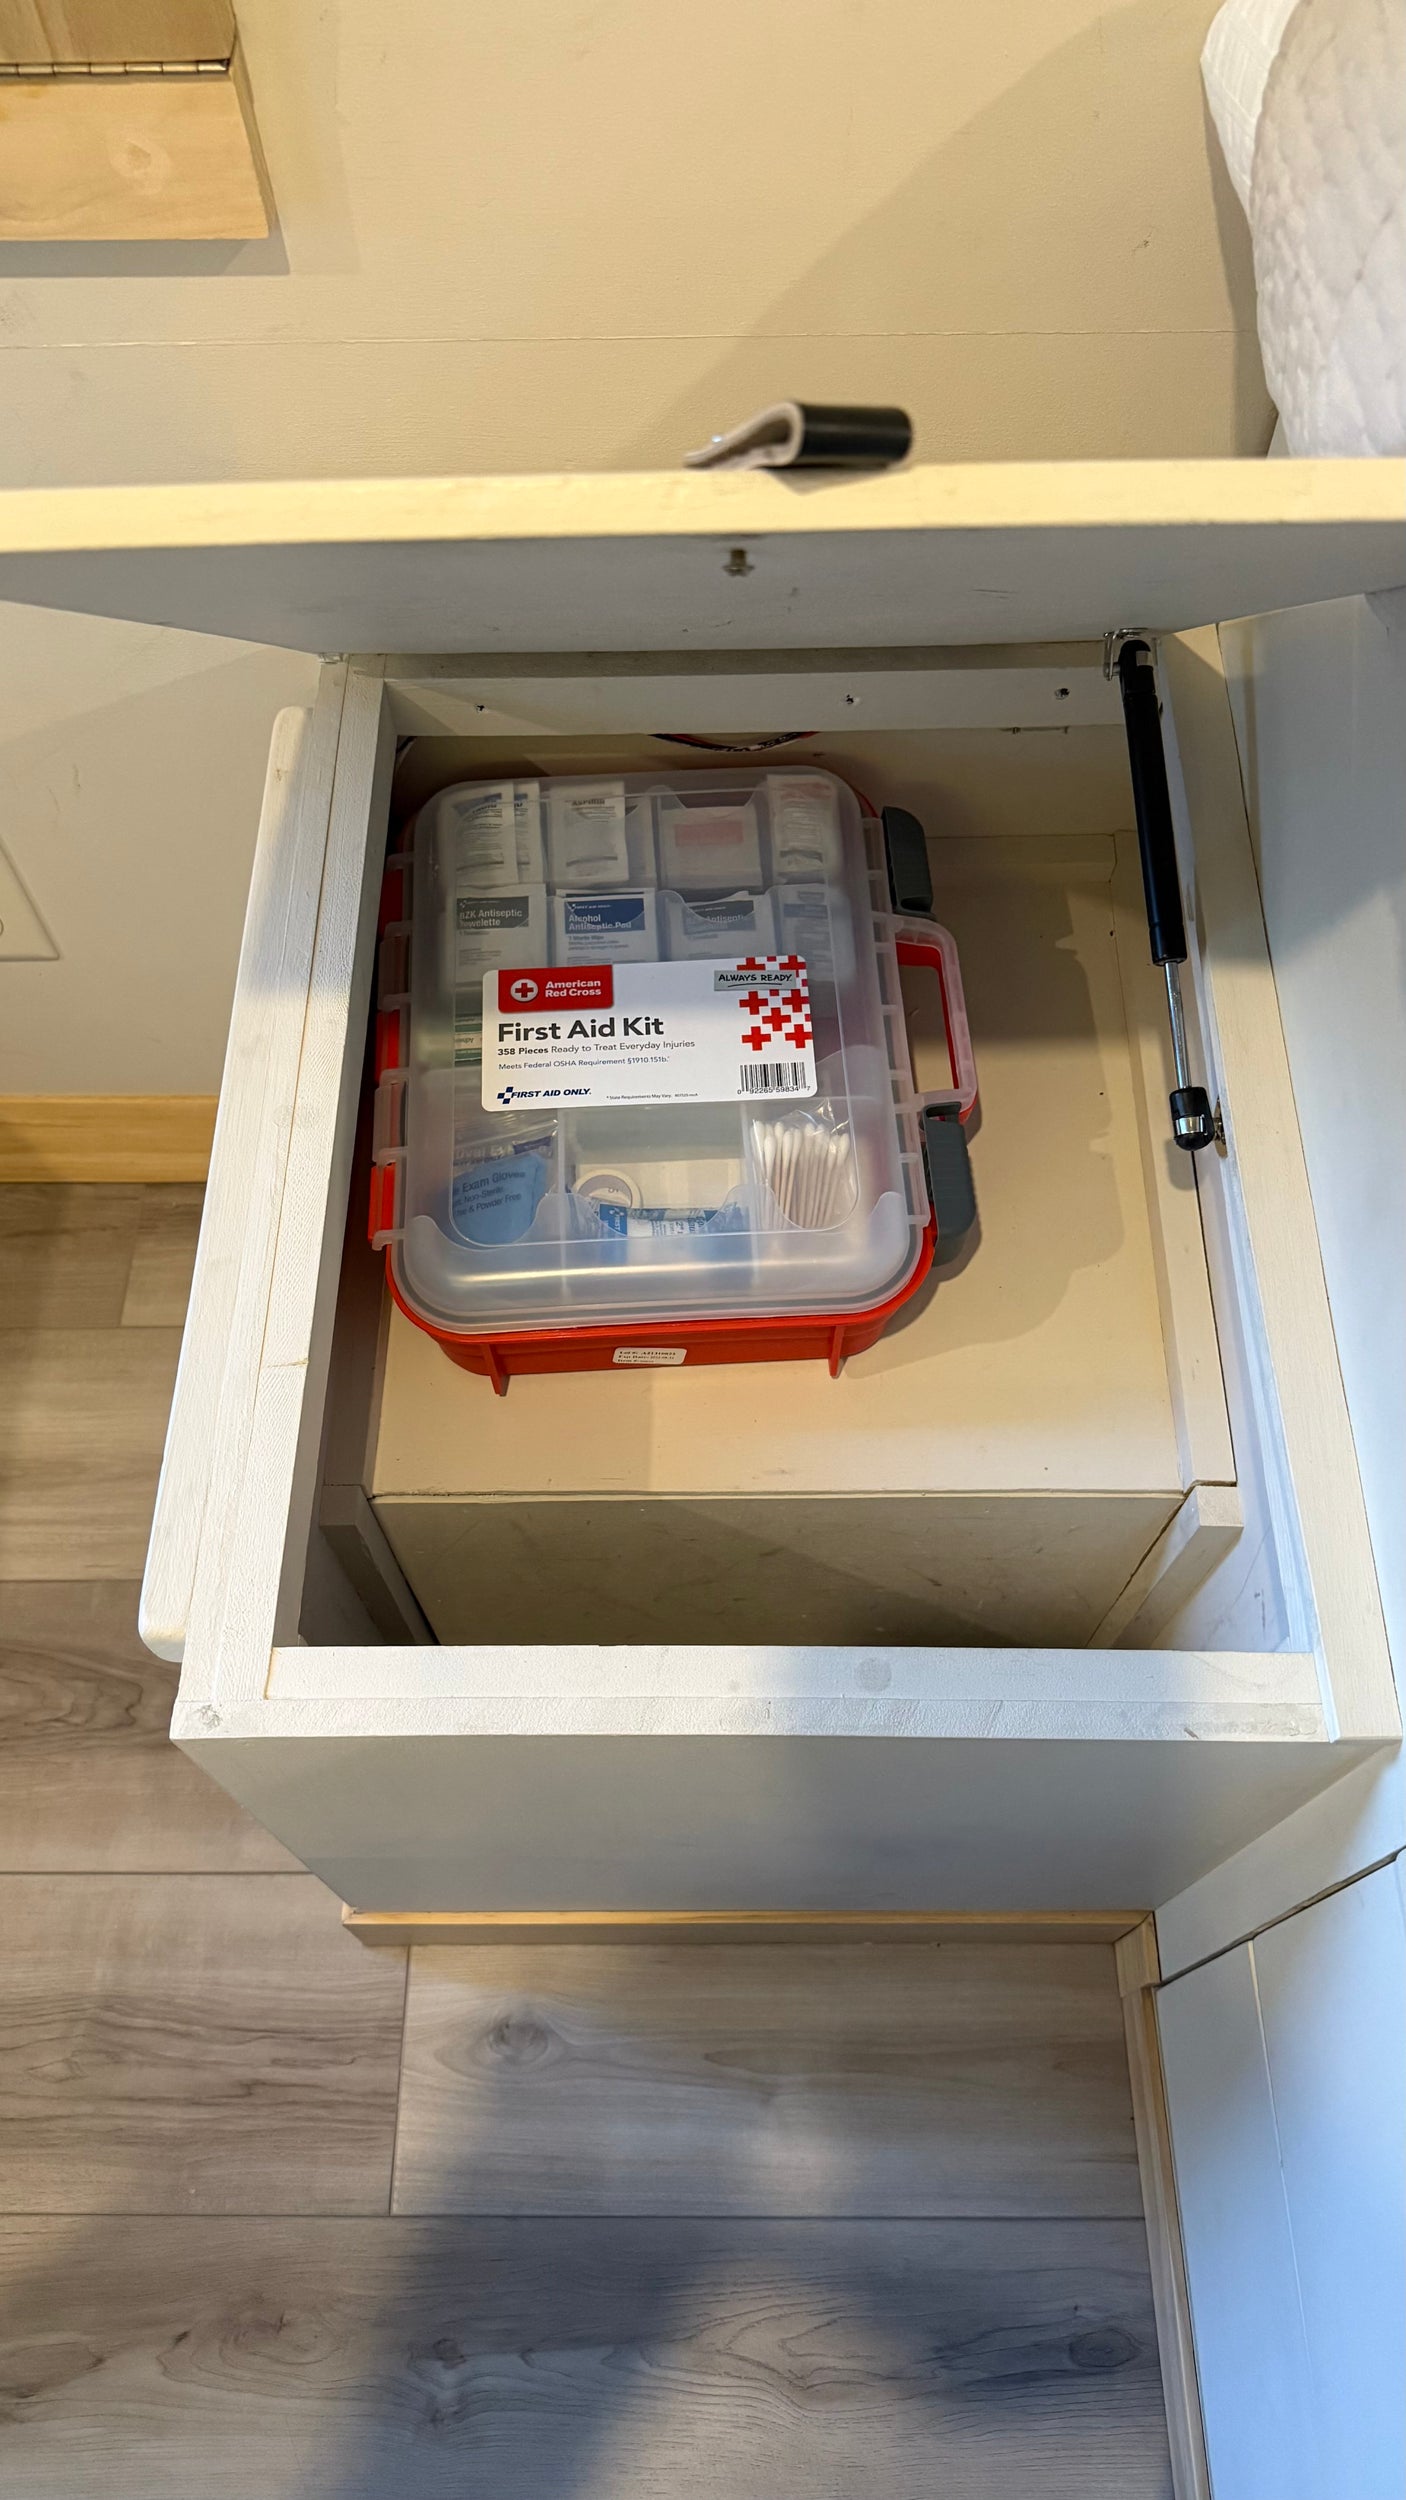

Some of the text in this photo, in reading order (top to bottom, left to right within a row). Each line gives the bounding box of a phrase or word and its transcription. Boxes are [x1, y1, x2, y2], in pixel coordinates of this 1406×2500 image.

[478, 908, 523, 918] Antiseptic
[569, 914, 601, 922] Alcohol
[718, 974, 757, 982] ALWAYS
[545, 979, 602, 989] American
[545, 987, 602, 998] Red Cross
[498, 1016, 664, 1042] First Aid Kit
[498, 1048, 516, 1056] 358
[518, 1047, 549, 1055] Pieces
[551, 1045, 580, 1054] Ready
[594, 1043, 617, 1051] Treat
[619, 1041, 661, 1051] Everyday
[663, 1040, 695, 1050] Injuries
[523, 1061, 552, 1069] Federal
[578, 1058, 626, 1066] Requirement
[510, 1090, 541, 1099] FIRST
[543, 1089, 561, 1097] AID
[776, 1085, 799, 1093] 59834
[463, 1177, 489, 1193] Exam
[492, 1171, 526, 1183] Gloves
